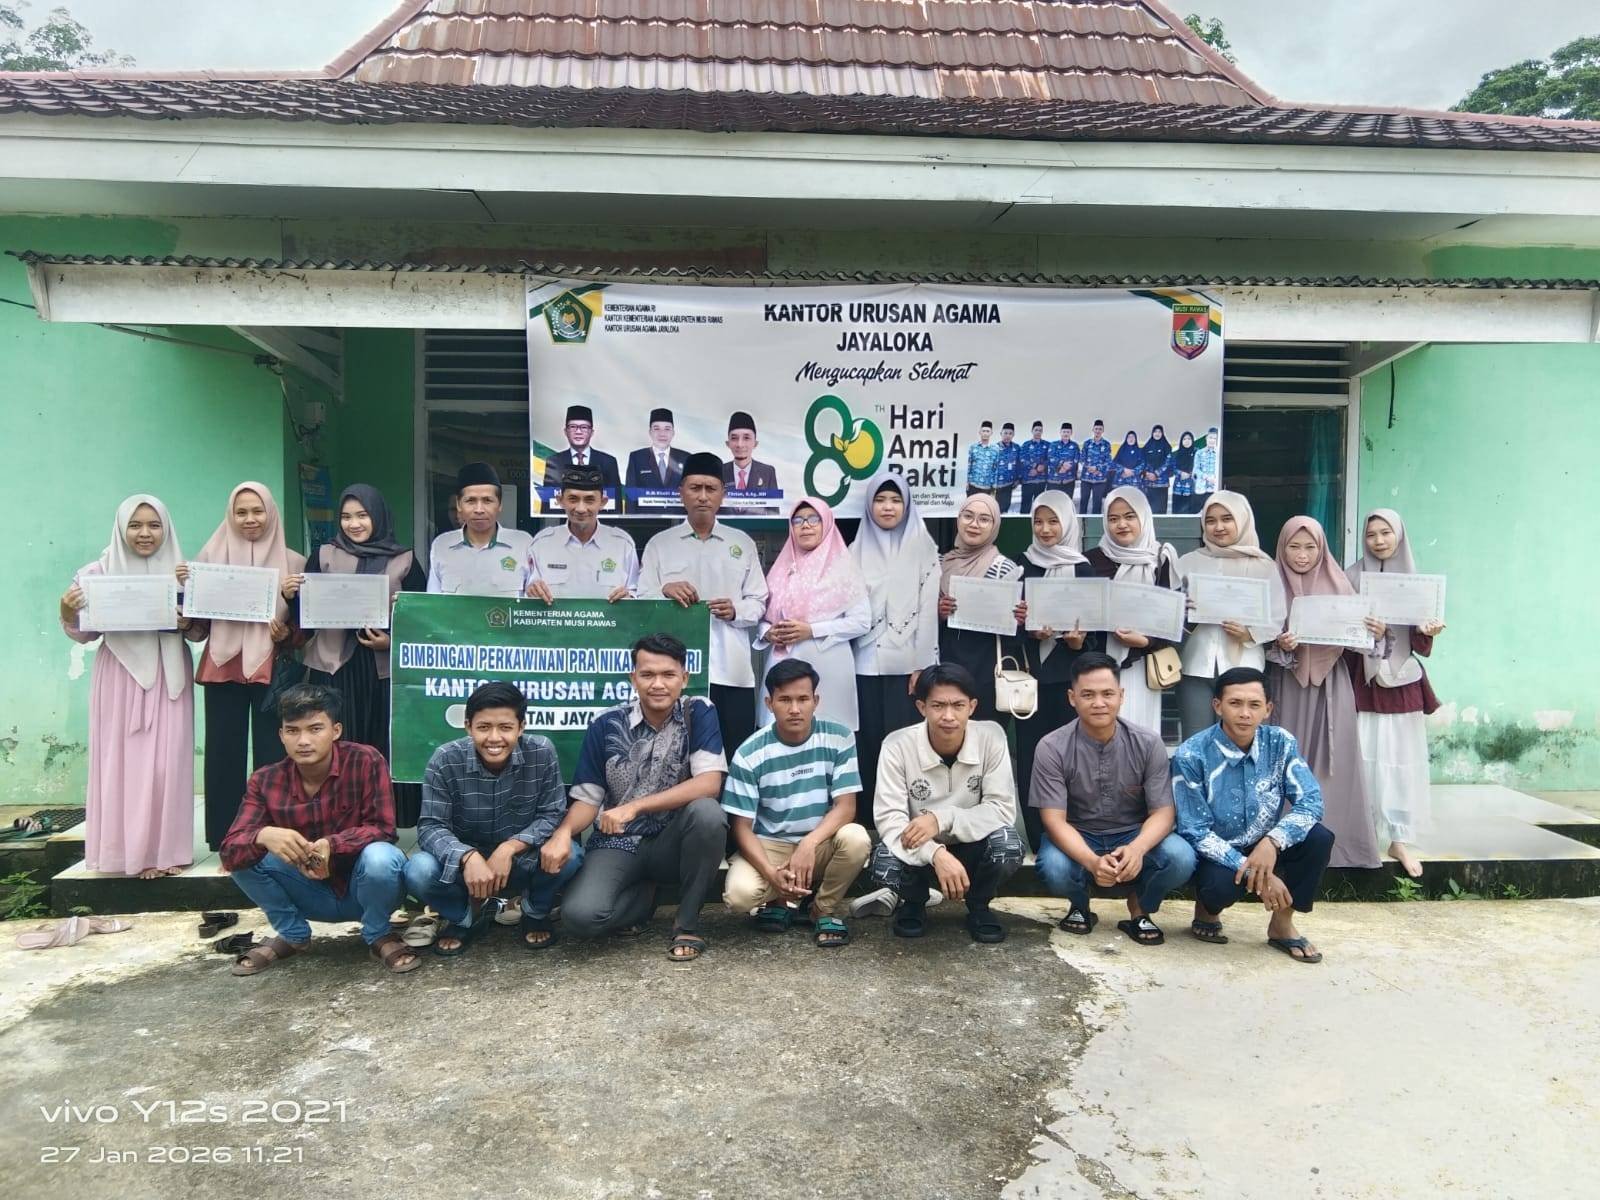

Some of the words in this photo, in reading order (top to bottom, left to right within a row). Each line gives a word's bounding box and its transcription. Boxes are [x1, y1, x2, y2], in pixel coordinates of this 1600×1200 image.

[764, 303, 842, 322] KANTOR
[849, 303, 926, 323] URUSAN
[933, 304, 1001, 323] AGAMA
[836, 332, 933, 351] JAYALOKA
[795, 360, 902, 387] Mengucapkan
[909, 360, 978, 383] Selamat
[889, 402, 944, 429] Hari
[888, 433, 958, 459] Amal
[513, 610, 572, 618] KEMENTERIAN
[574, 610, 605, 618] AGAMA
[513, 618, 562, 626] KABUPATEN
[401, 644, 475, 670] BIMBINGAN
[479, 647, 565, 672] PERKAWINAN
[569, 649, 598, 672] PRA
[600, 649, 635, 673] NIKA
[425, 677, 500, 697] KANT
